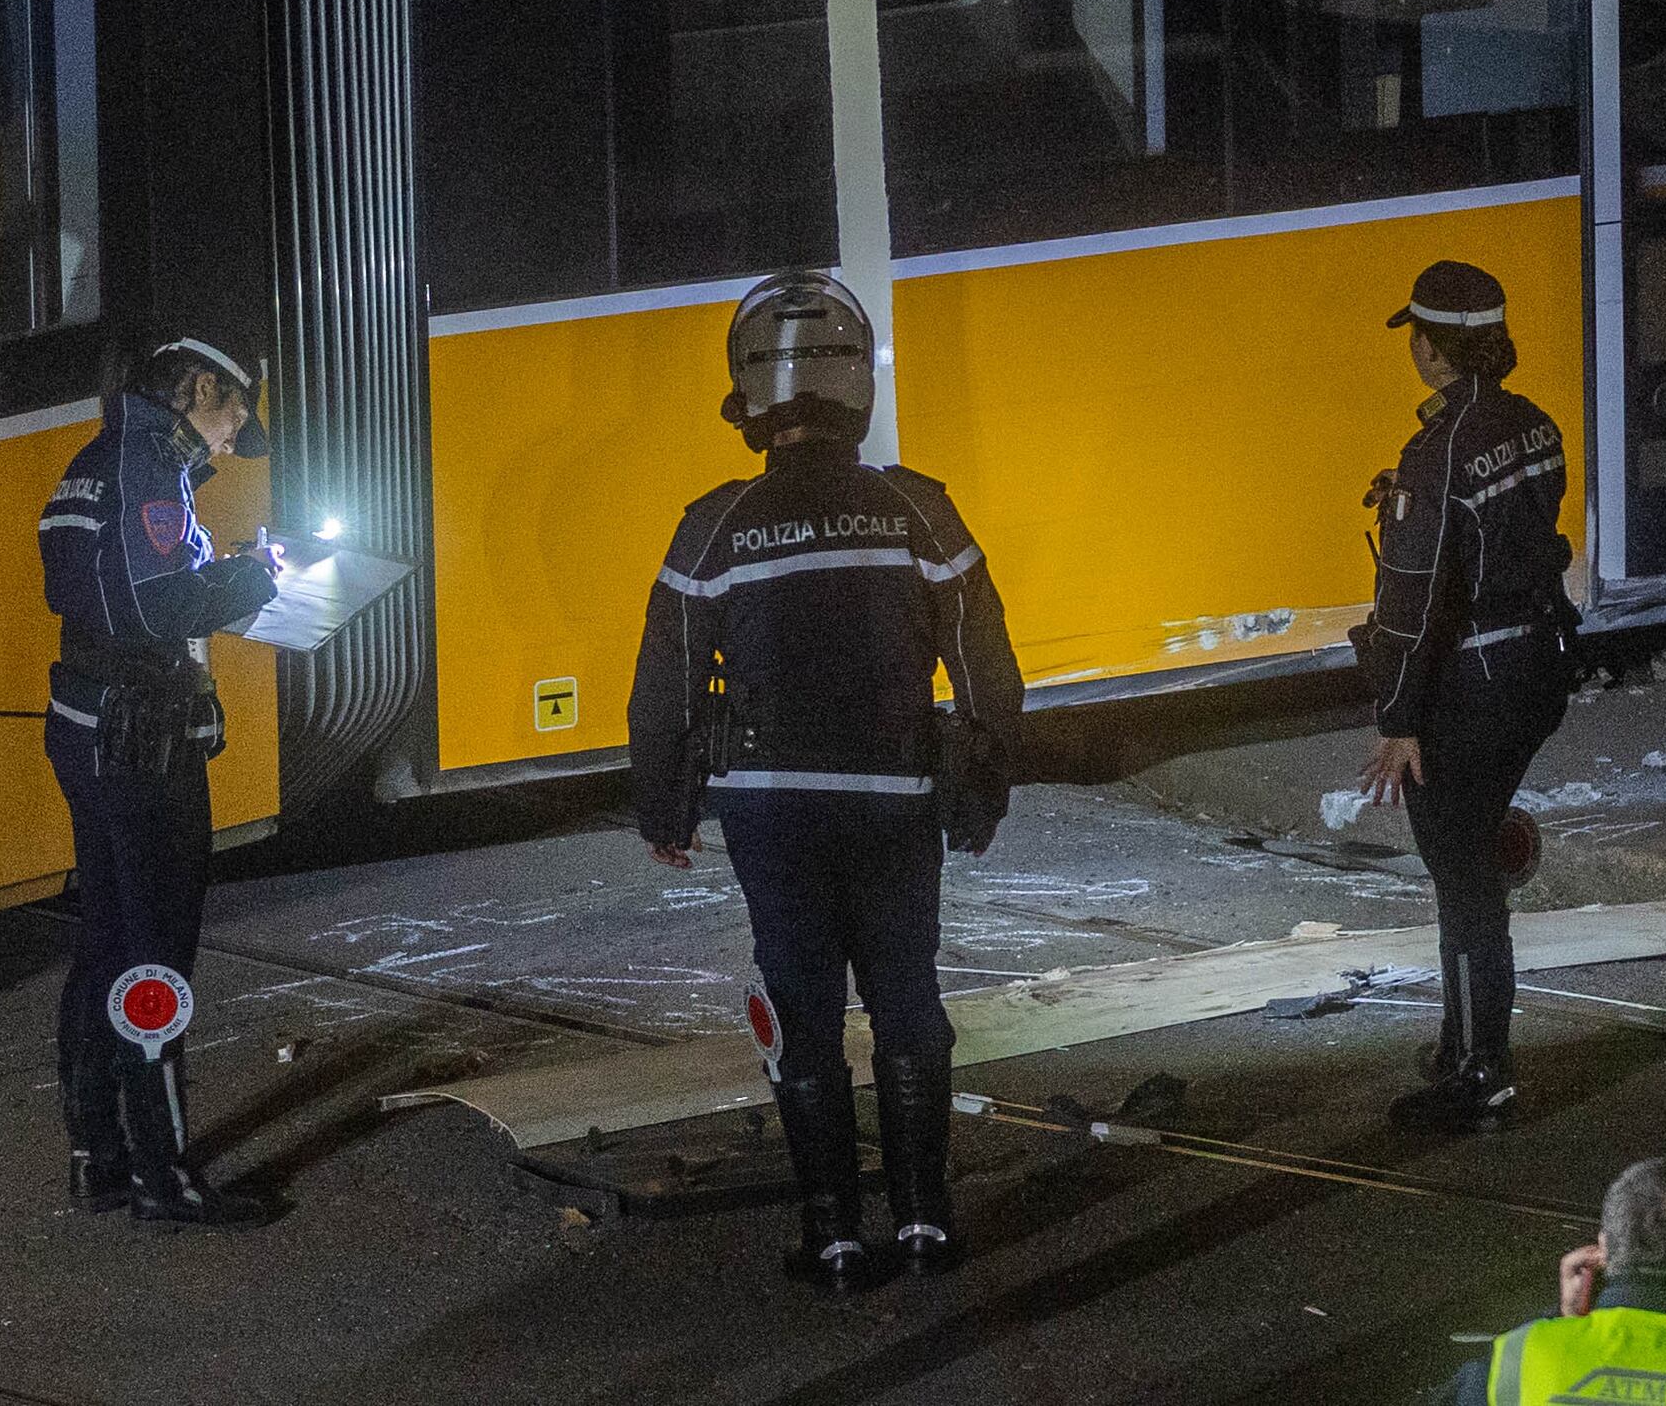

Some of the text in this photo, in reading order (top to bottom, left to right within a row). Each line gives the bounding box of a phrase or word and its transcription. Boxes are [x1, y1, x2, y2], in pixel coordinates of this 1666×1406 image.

[732, 514, 909, 553] POLIZIA LOCALE
[113, 969, 189, 1011] COMUNE DI MILANO
